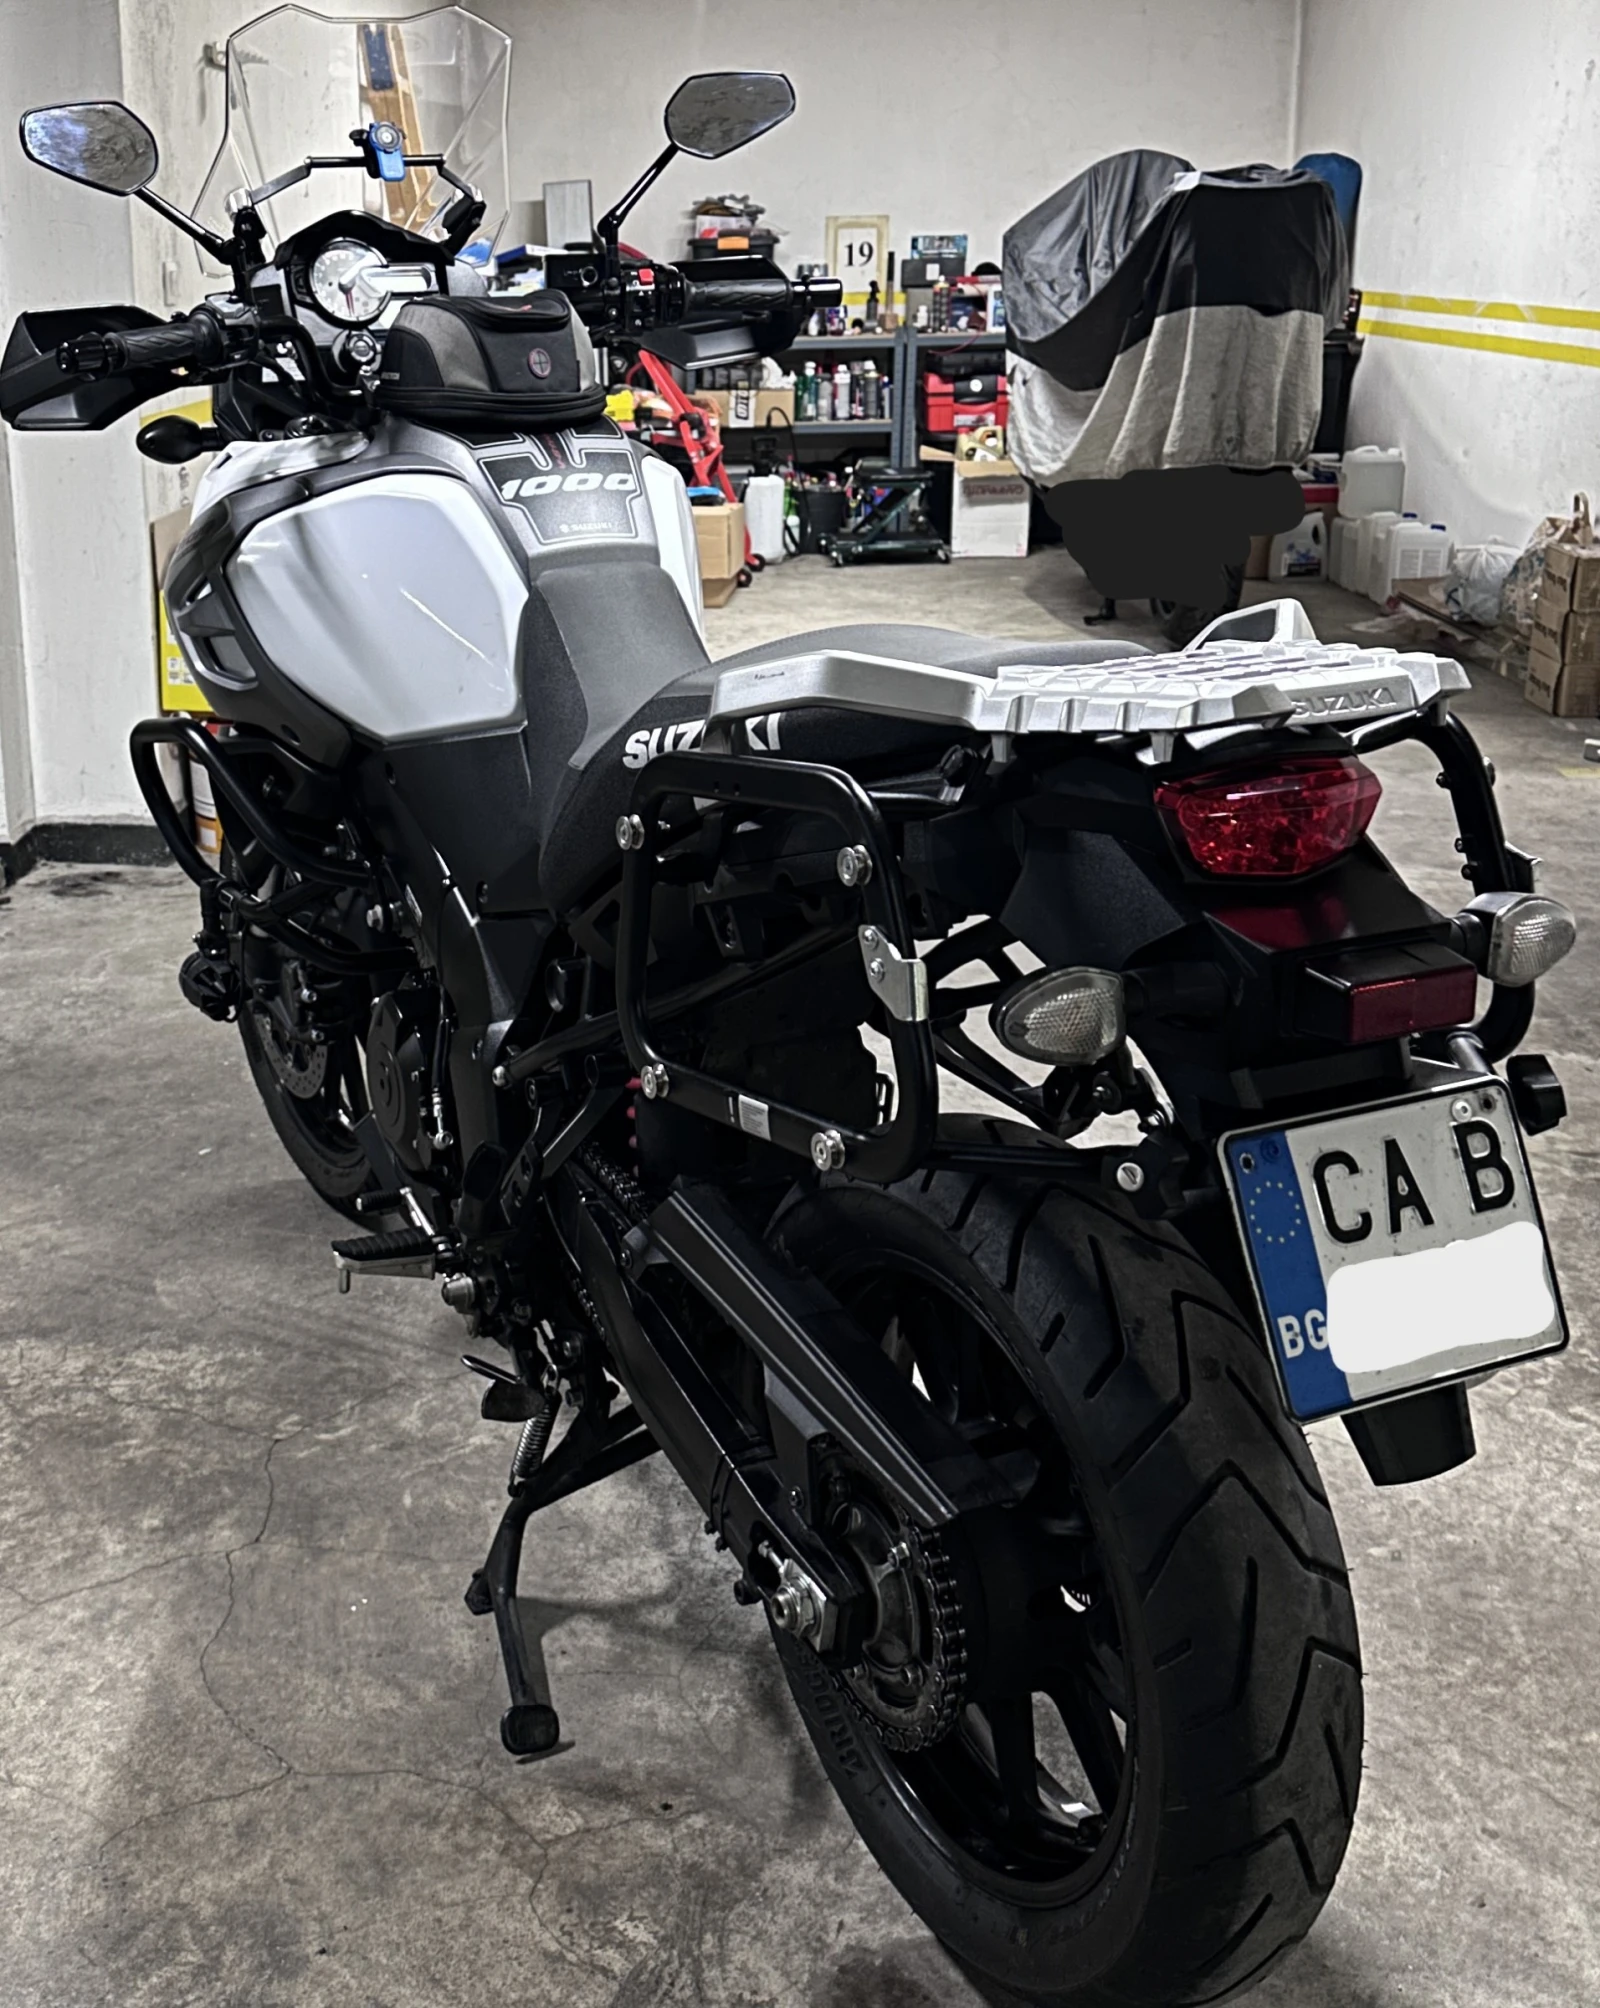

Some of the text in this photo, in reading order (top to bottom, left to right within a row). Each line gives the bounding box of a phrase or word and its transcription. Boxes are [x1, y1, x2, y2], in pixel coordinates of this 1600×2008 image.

[844, 240, 874, 267] 19
[501, 472, 637, 500] 1000
[571, 521, 612, 532] SUZUKI
[1290, 687, 1397, 718] SUZUKI
[622, 712, 782, 769] SUZKI
[1277, 1309, 1329, 1358] BG
